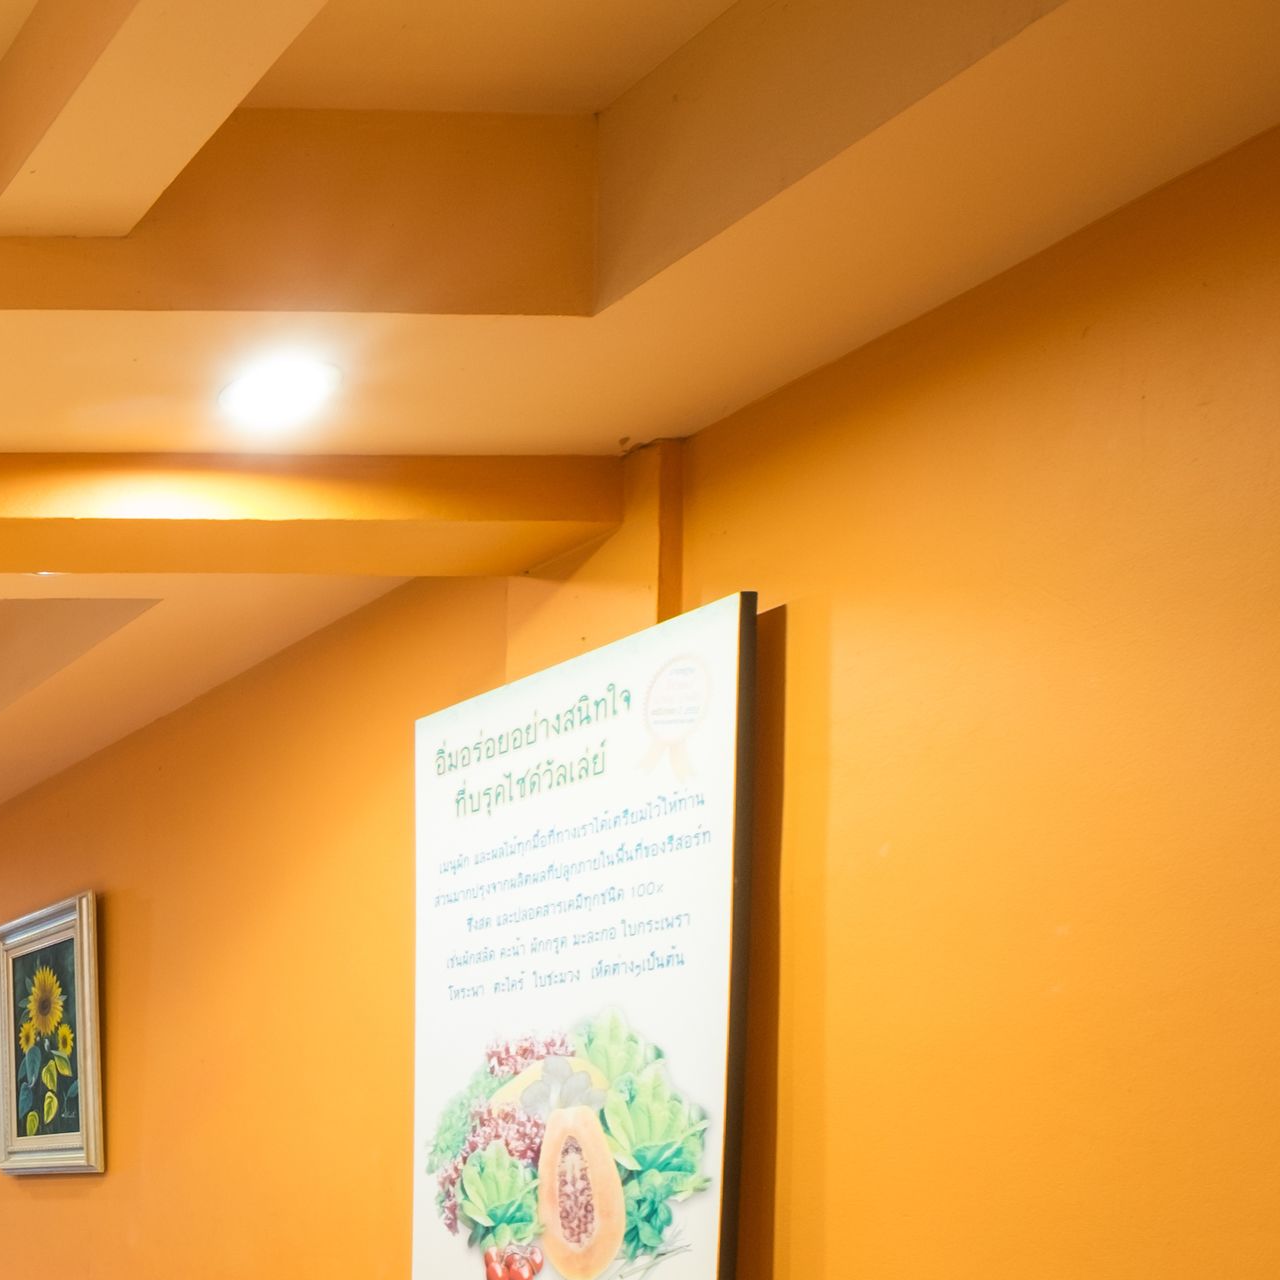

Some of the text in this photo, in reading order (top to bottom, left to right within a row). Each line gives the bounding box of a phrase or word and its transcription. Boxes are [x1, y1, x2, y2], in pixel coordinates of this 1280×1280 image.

[434, 682, 632, 776] อิ่มอร่อยอย่างสนิทใจ
[439, 853, 469, 875] เมนูผัก
